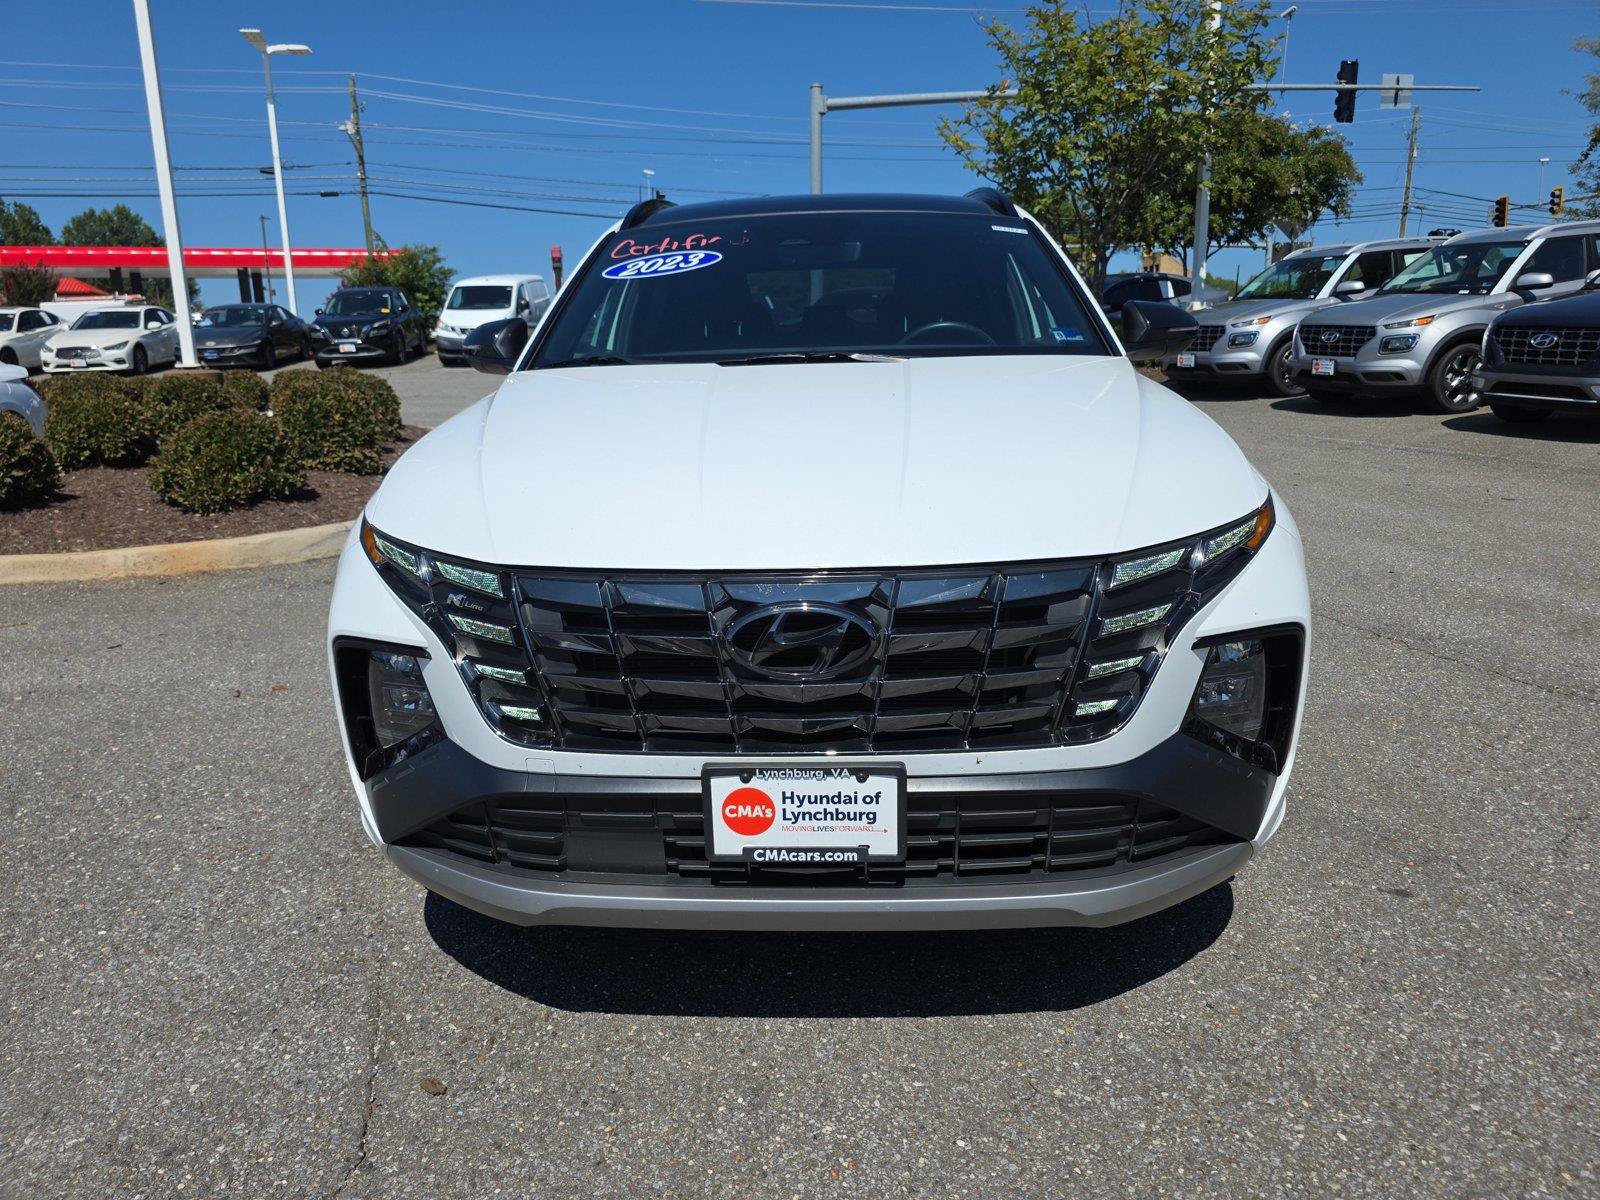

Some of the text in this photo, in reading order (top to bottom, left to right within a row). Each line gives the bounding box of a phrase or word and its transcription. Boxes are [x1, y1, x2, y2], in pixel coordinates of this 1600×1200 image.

[618, 252, 706, 277] 2023
[755, 768, 851, 780] Lynchburg, VA
[781, 791, 882, 808] Hyundai of
[724, 804, 773, 818] CMA's
[781, 808, 878, 824] Lynchburg
[753, 849, 858, 862] CMAcars.com
